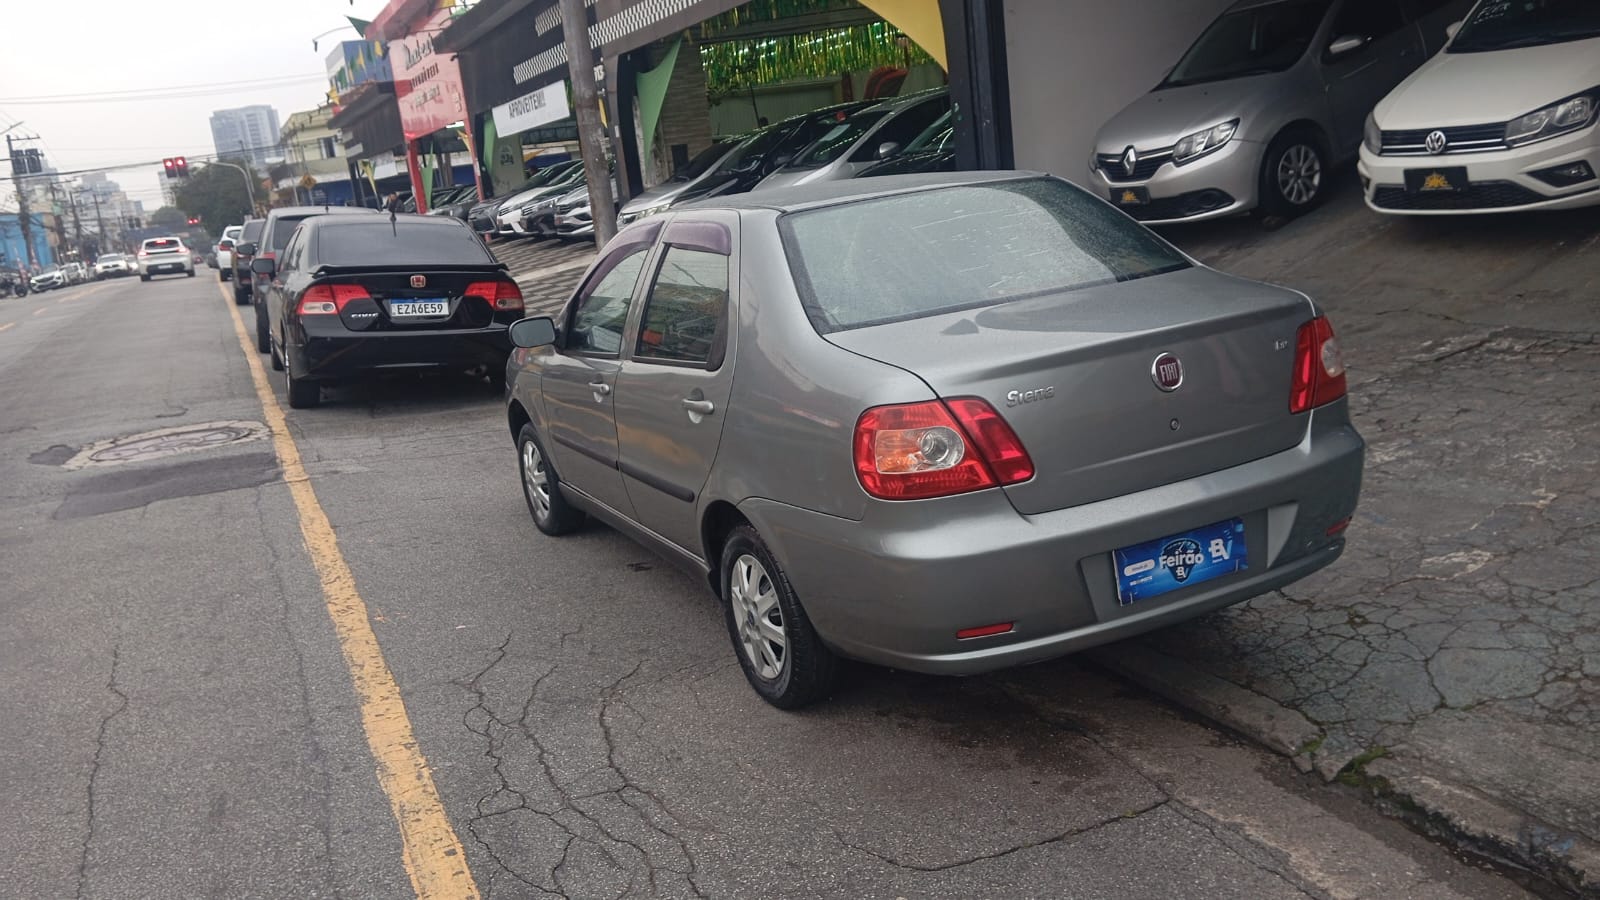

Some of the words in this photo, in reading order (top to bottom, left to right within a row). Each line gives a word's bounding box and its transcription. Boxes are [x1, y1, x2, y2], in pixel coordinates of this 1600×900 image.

[397, 303, 443, 315] EZA6E59
[1159, 362, 1178, 383] FIAT
[1007, 386, 1055, 408] Siena
[1159, 550, 1204, 568] Feirão
